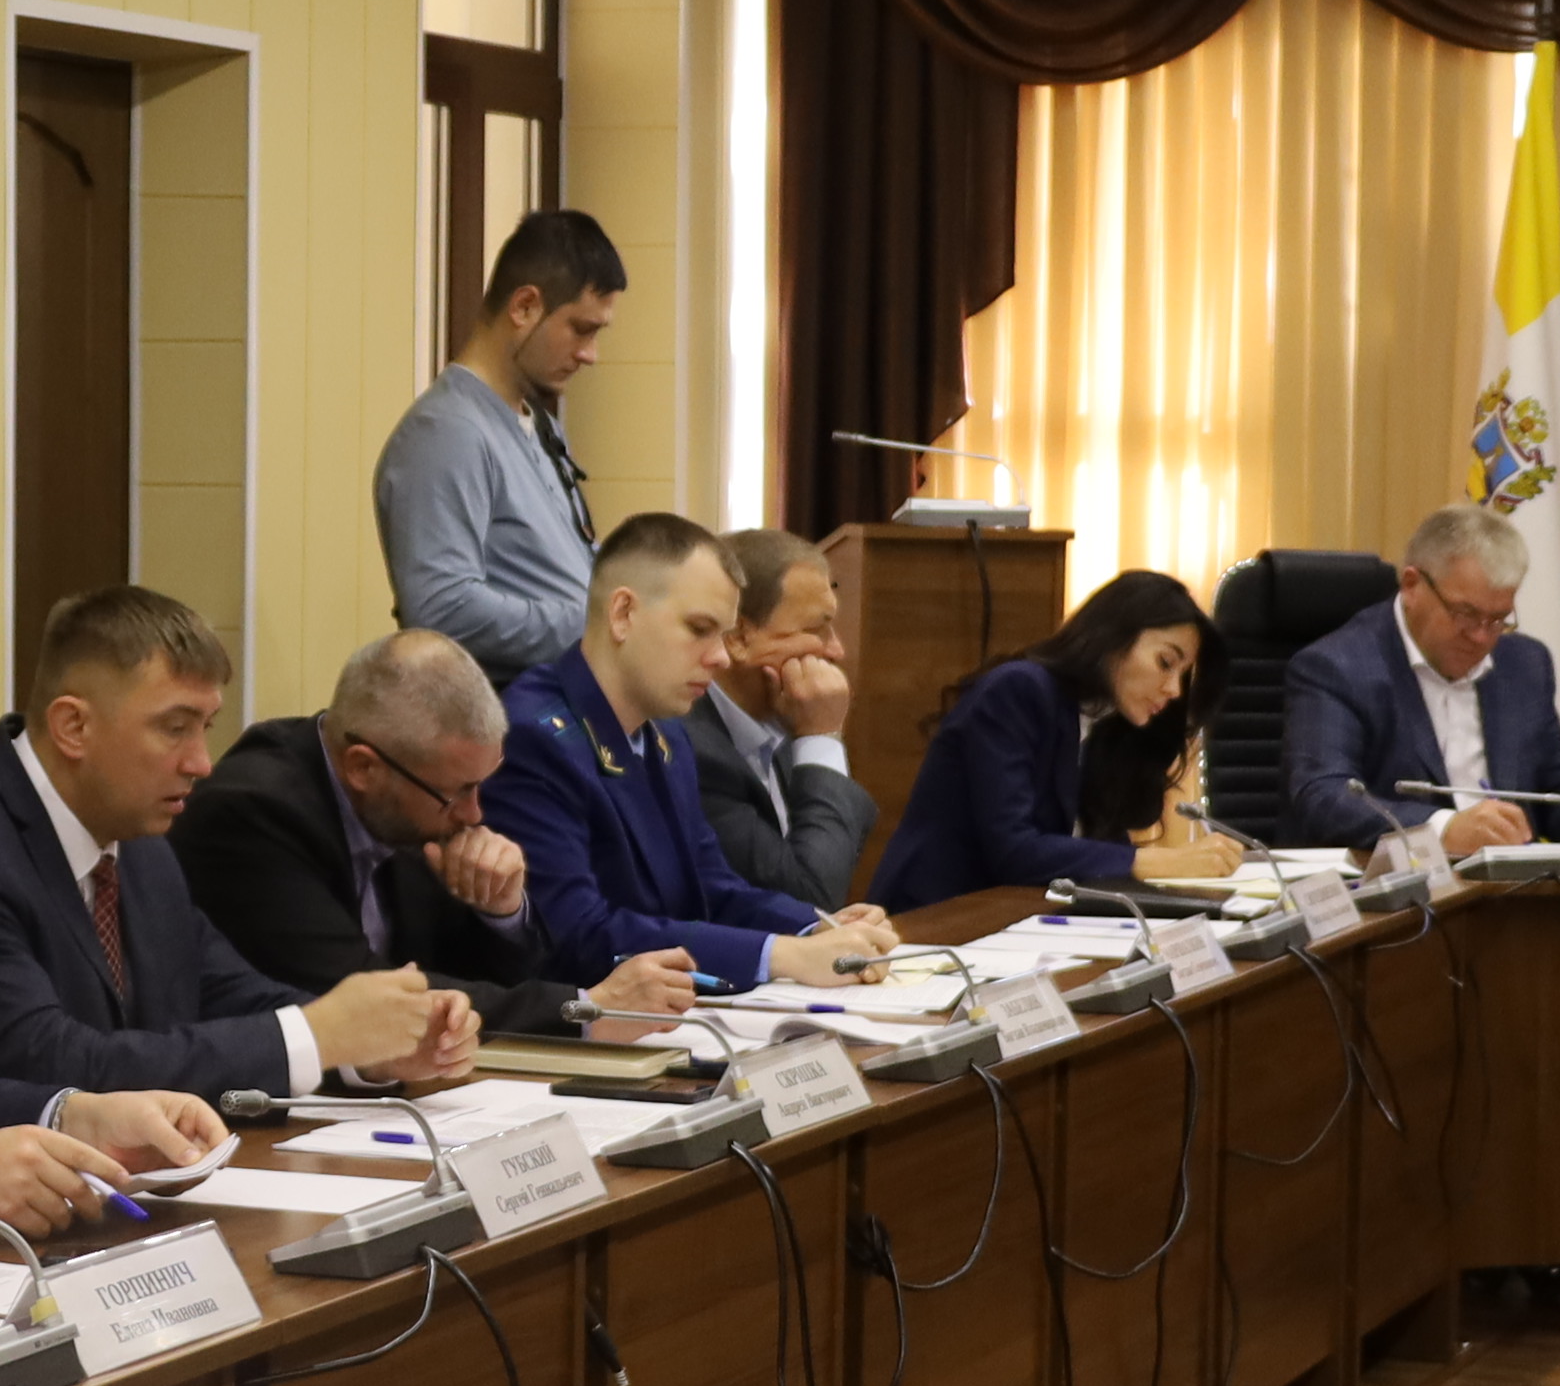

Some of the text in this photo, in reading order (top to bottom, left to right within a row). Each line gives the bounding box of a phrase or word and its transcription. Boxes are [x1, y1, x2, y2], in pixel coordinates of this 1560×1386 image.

[500, 1141, 558, 1179] ГУБСКИЙ
[94, 1260, 197, 1310] ГОРПИНИЧ
[151, 1296, 220, 1332] Ивановна
